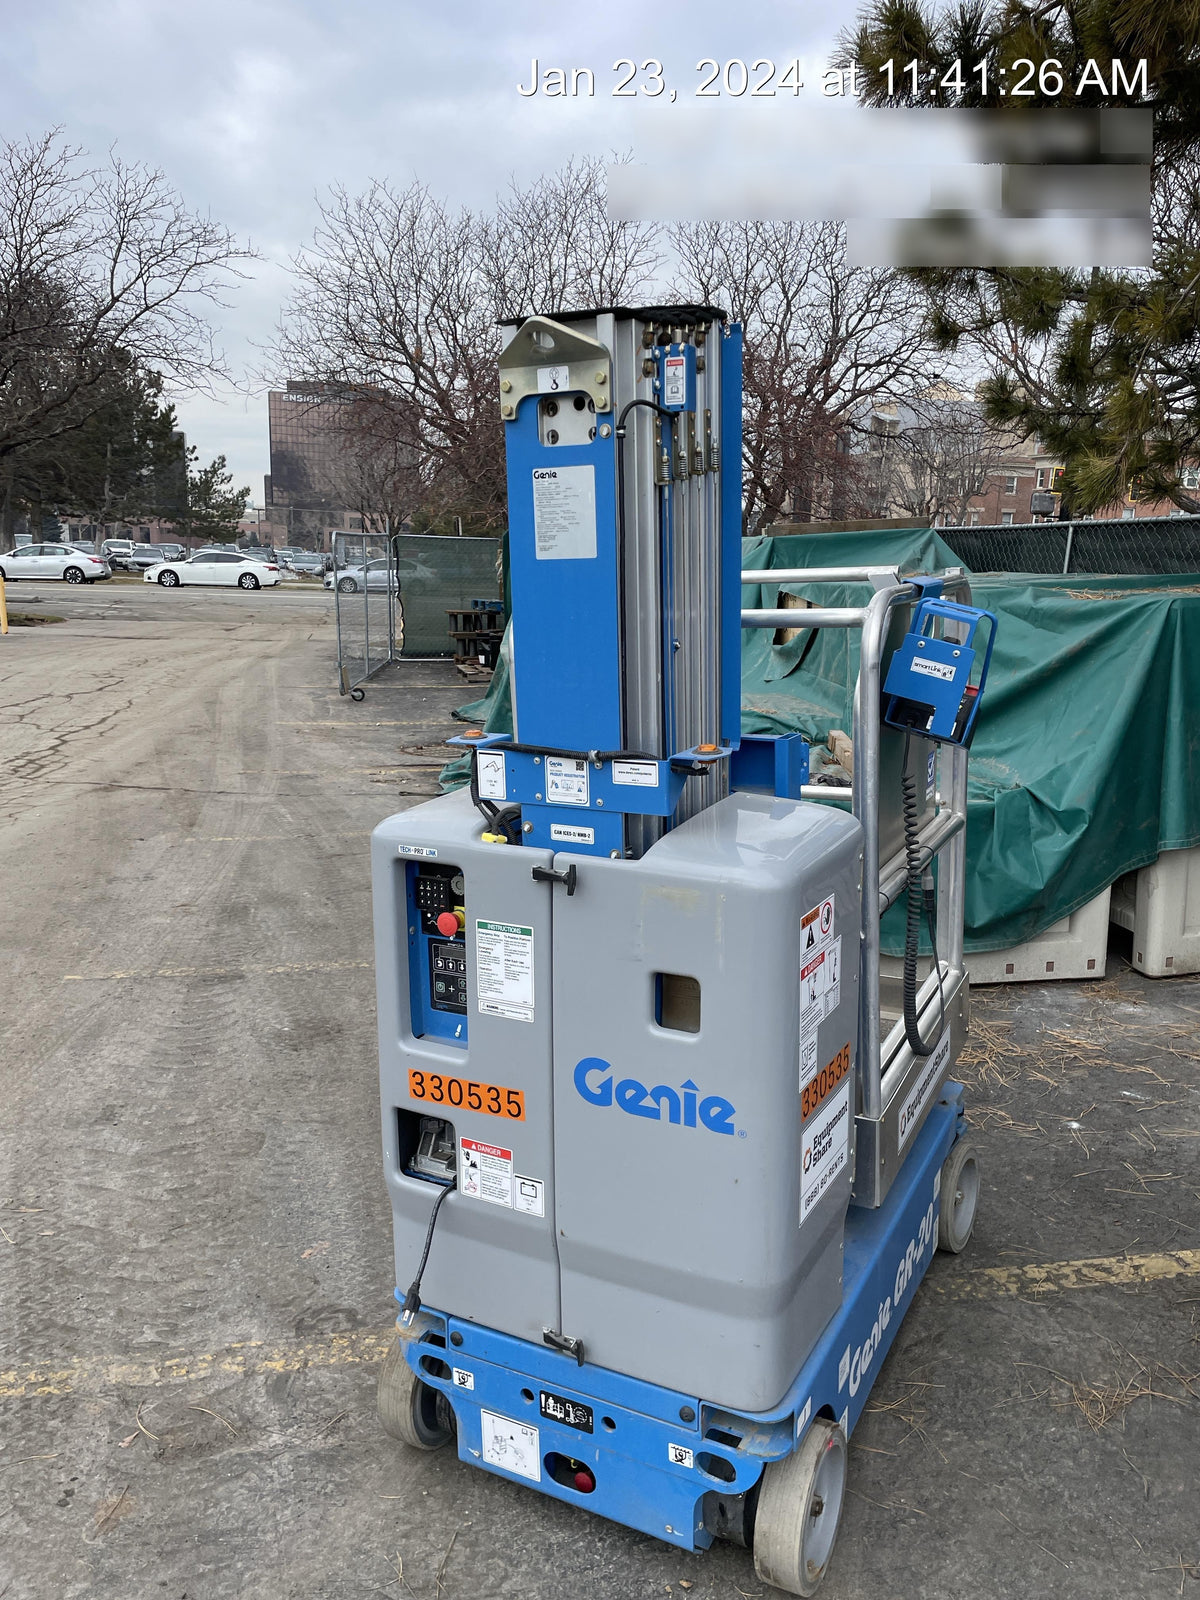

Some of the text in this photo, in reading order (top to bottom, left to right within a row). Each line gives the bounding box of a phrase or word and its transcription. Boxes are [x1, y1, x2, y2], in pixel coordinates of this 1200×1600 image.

[533, 470, 558, 480] Genie
[487, 924, 522, 934] INSTRUCTIONS
[411, 1071, 522, 1118] 330535
[573, 1056, 736, 1136] Genie
[803, 1044, 849, 1117] 330535
[813, 1100, 848, 1152] Equipment
[477, 1144, 502, 1157] DANGER
[812, 1136, 833, 1168] Share
[848, 1202, 934, 1398] Genie GR-20
